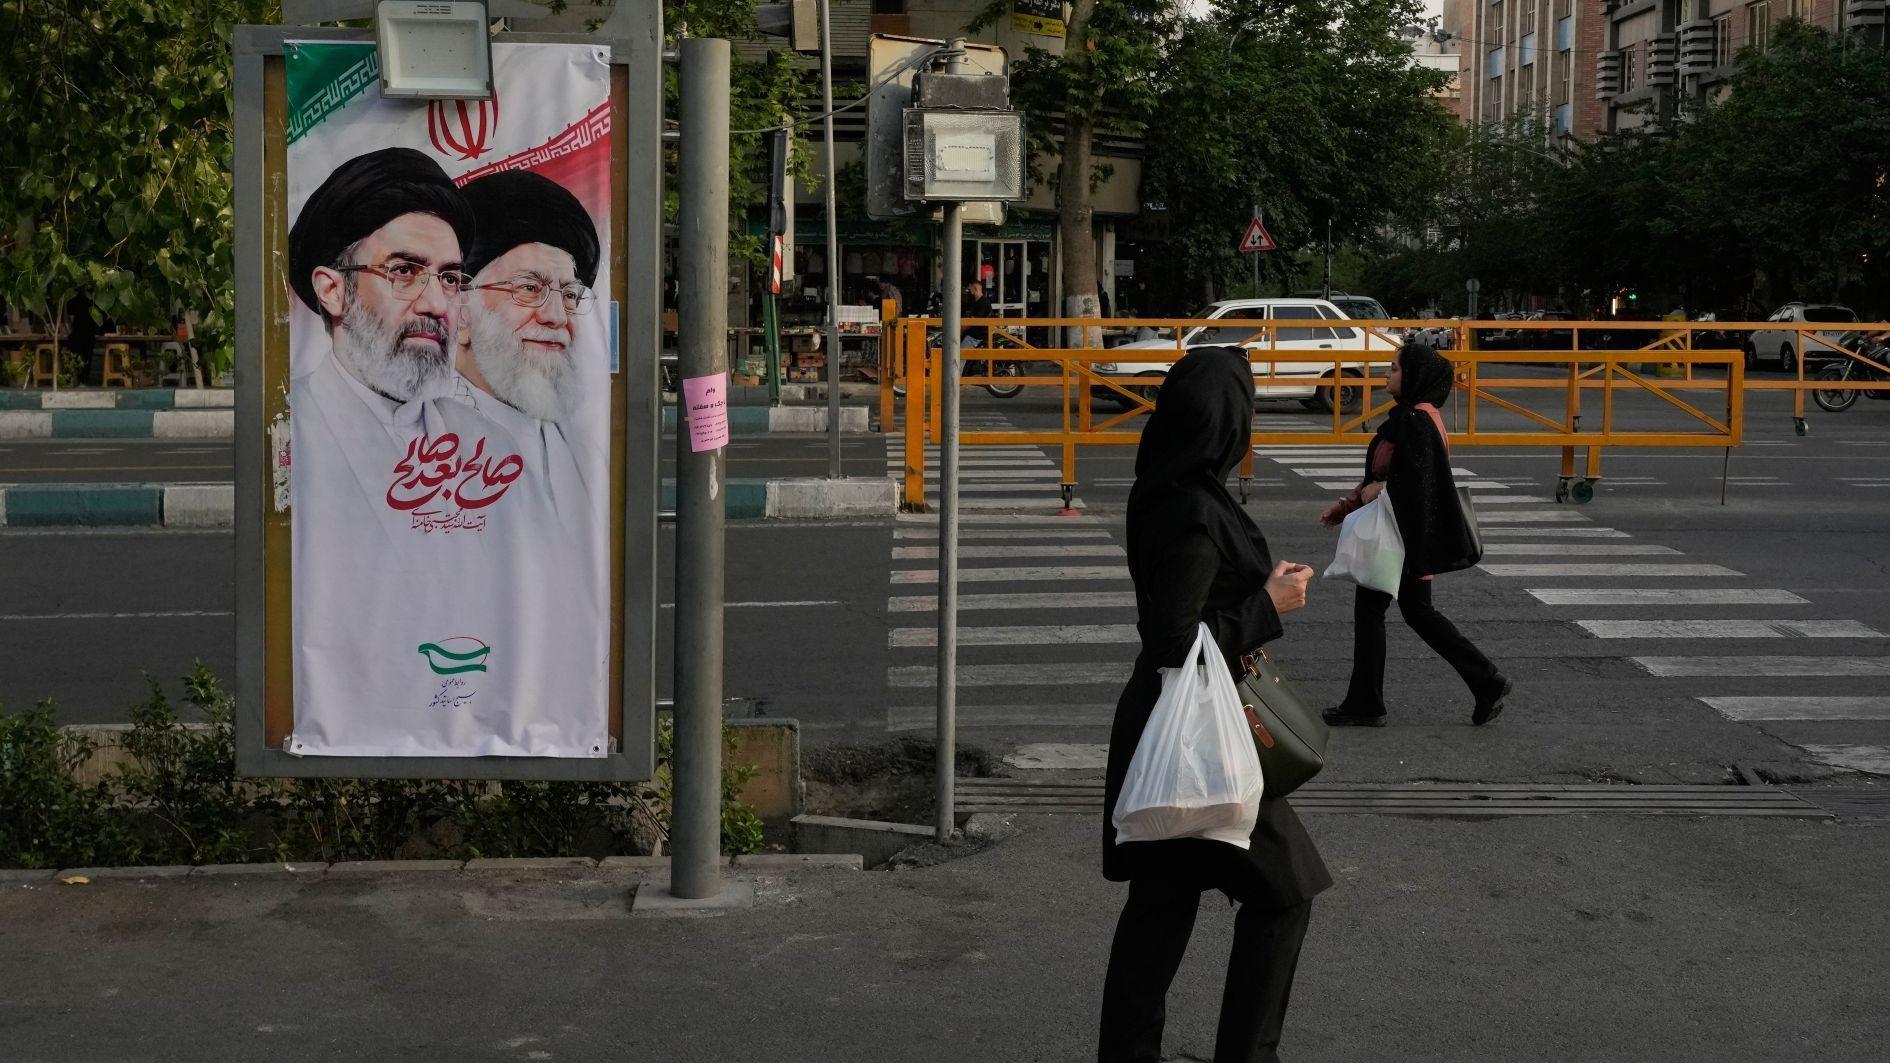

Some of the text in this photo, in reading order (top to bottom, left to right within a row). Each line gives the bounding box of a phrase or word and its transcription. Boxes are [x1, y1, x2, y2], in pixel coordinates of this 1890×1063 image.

[705, 387, 715, 396] وام
[455, 436, 524, 510] صالح
[463, 515, 487, 532] آیت
